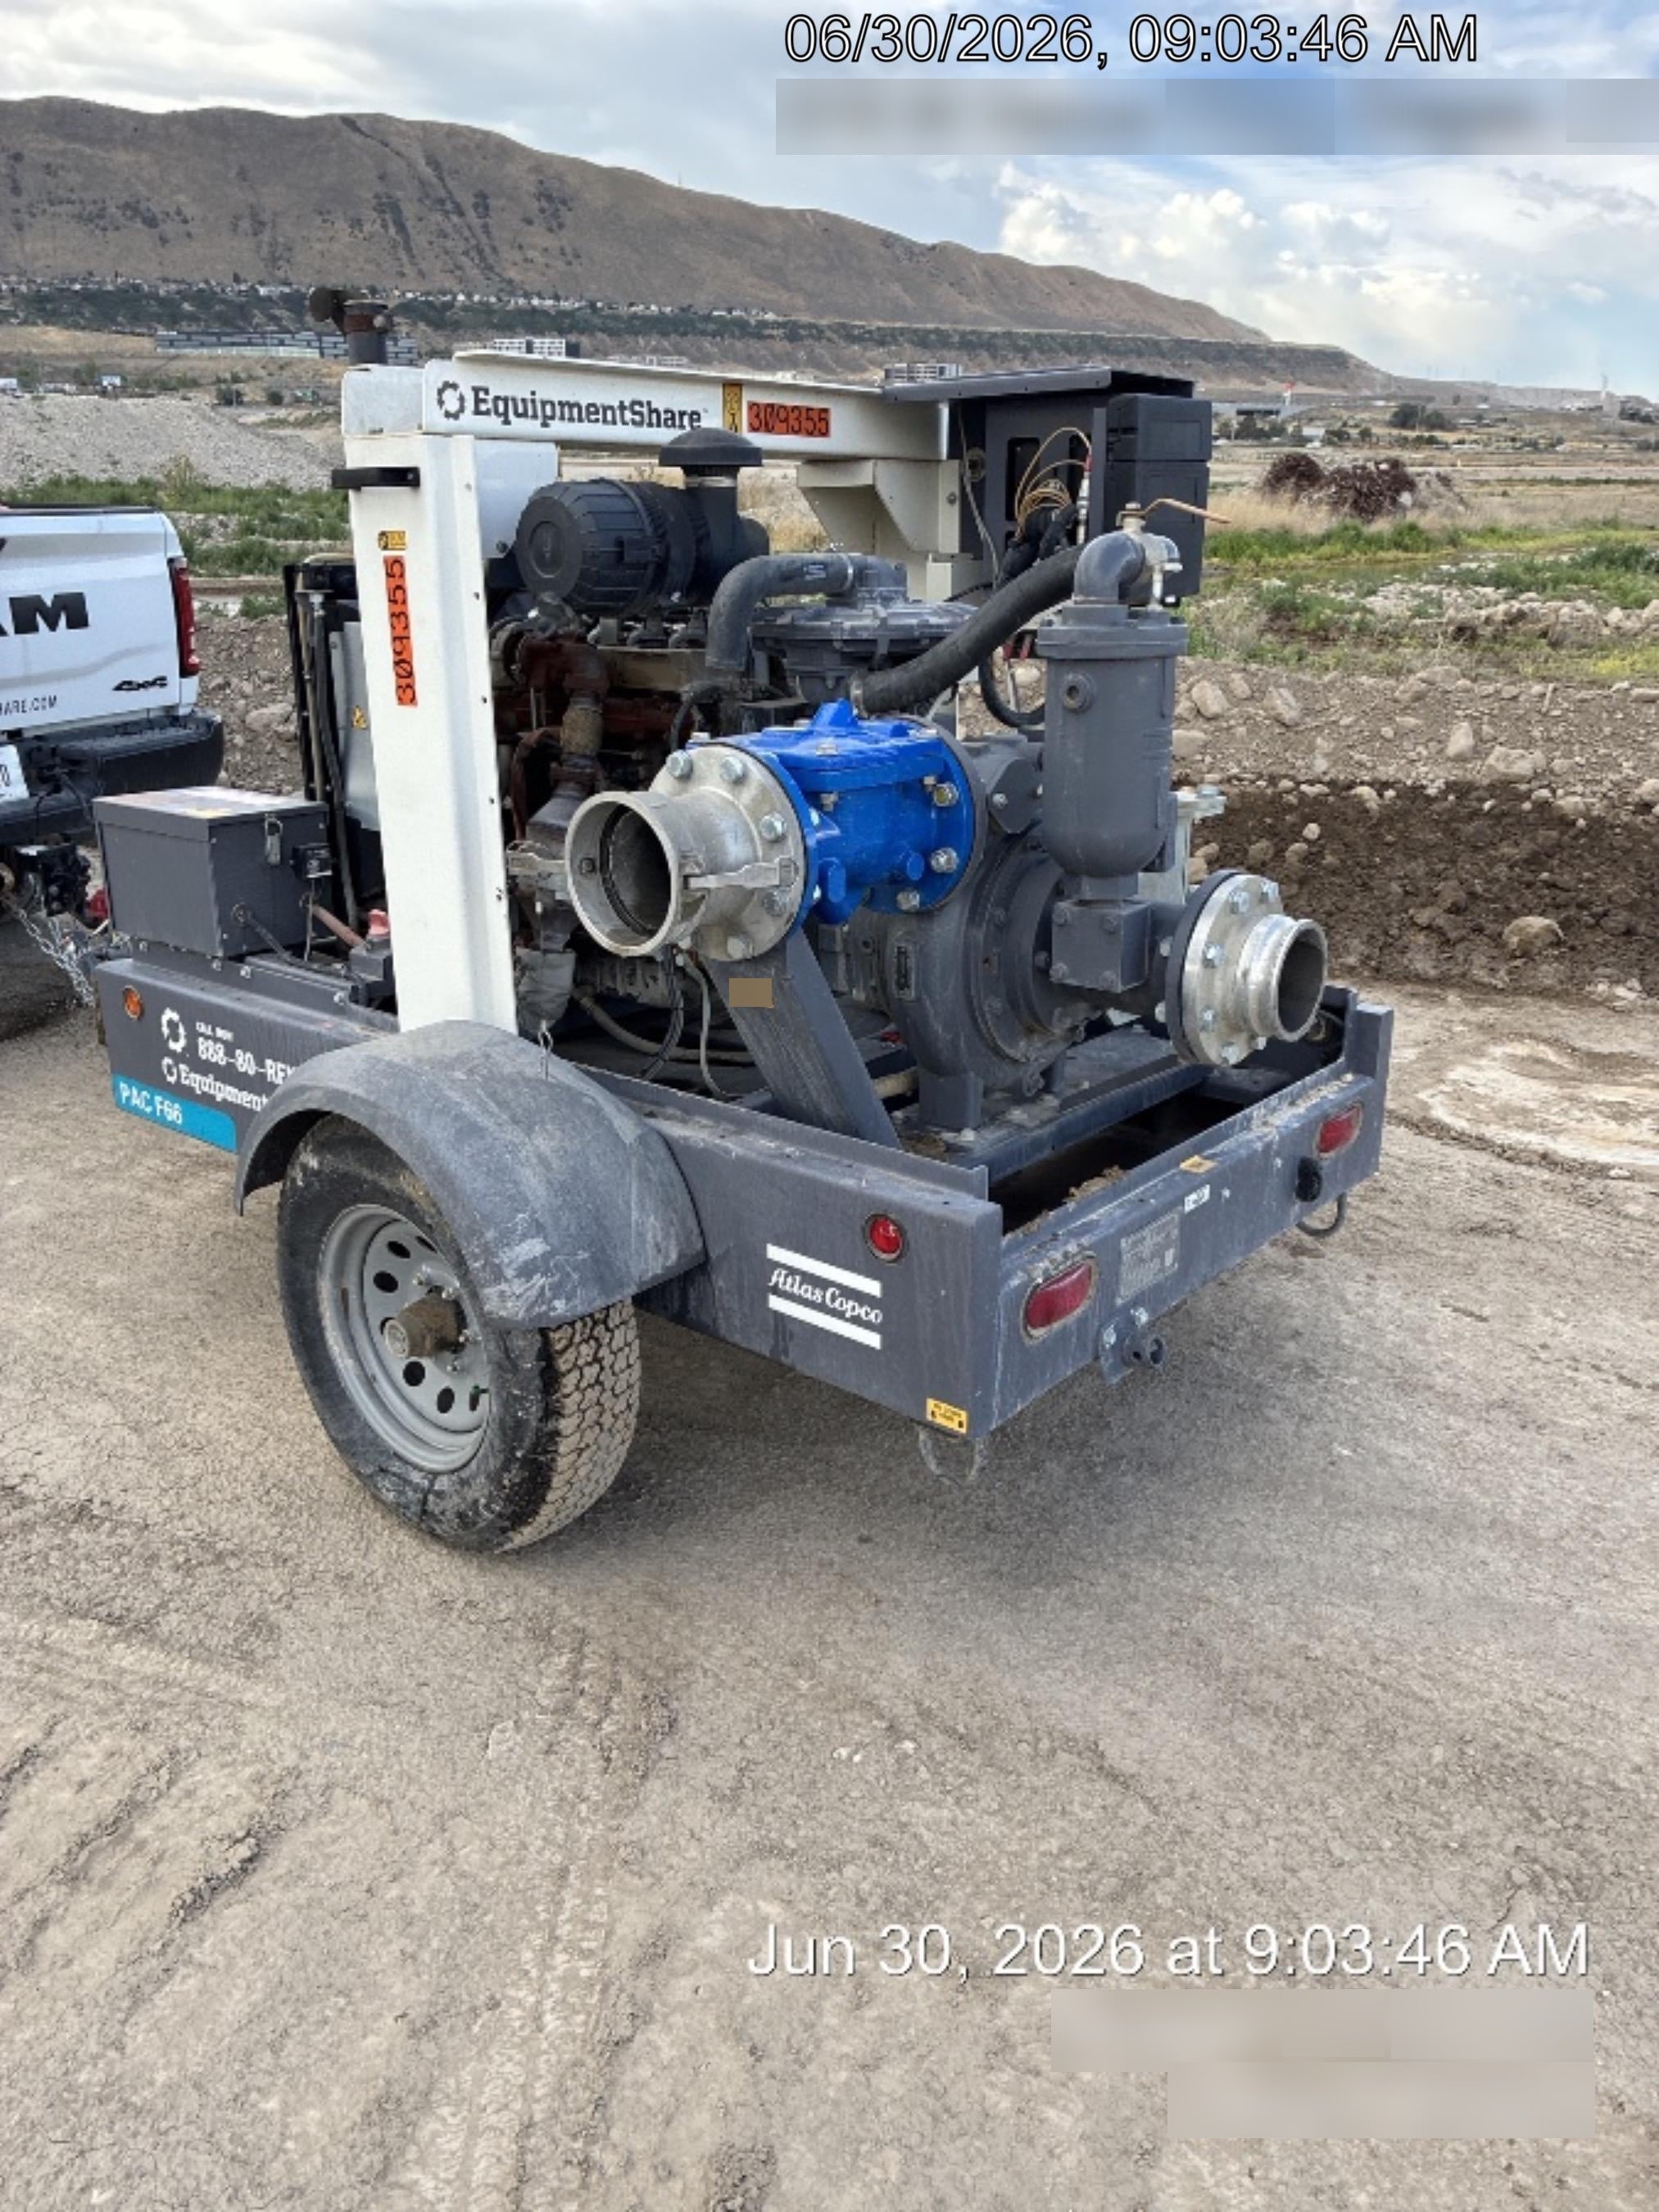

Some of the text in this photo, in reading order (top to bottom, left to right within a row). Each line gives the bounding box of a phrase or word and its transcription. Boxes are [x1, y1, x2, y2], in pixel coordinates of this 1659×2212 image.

[471, 385, 703, 429] EquipmentShare
[749, 403, 830, 437] 309355
[0, 592, 89, 637] M
[385, 560, 415, 703] 309355
[112, 676, 168, 691] 4x4
[120, 1081, 183, 1125] PAC F66
[768, 1268, 883, 1324] Atlas Copco
